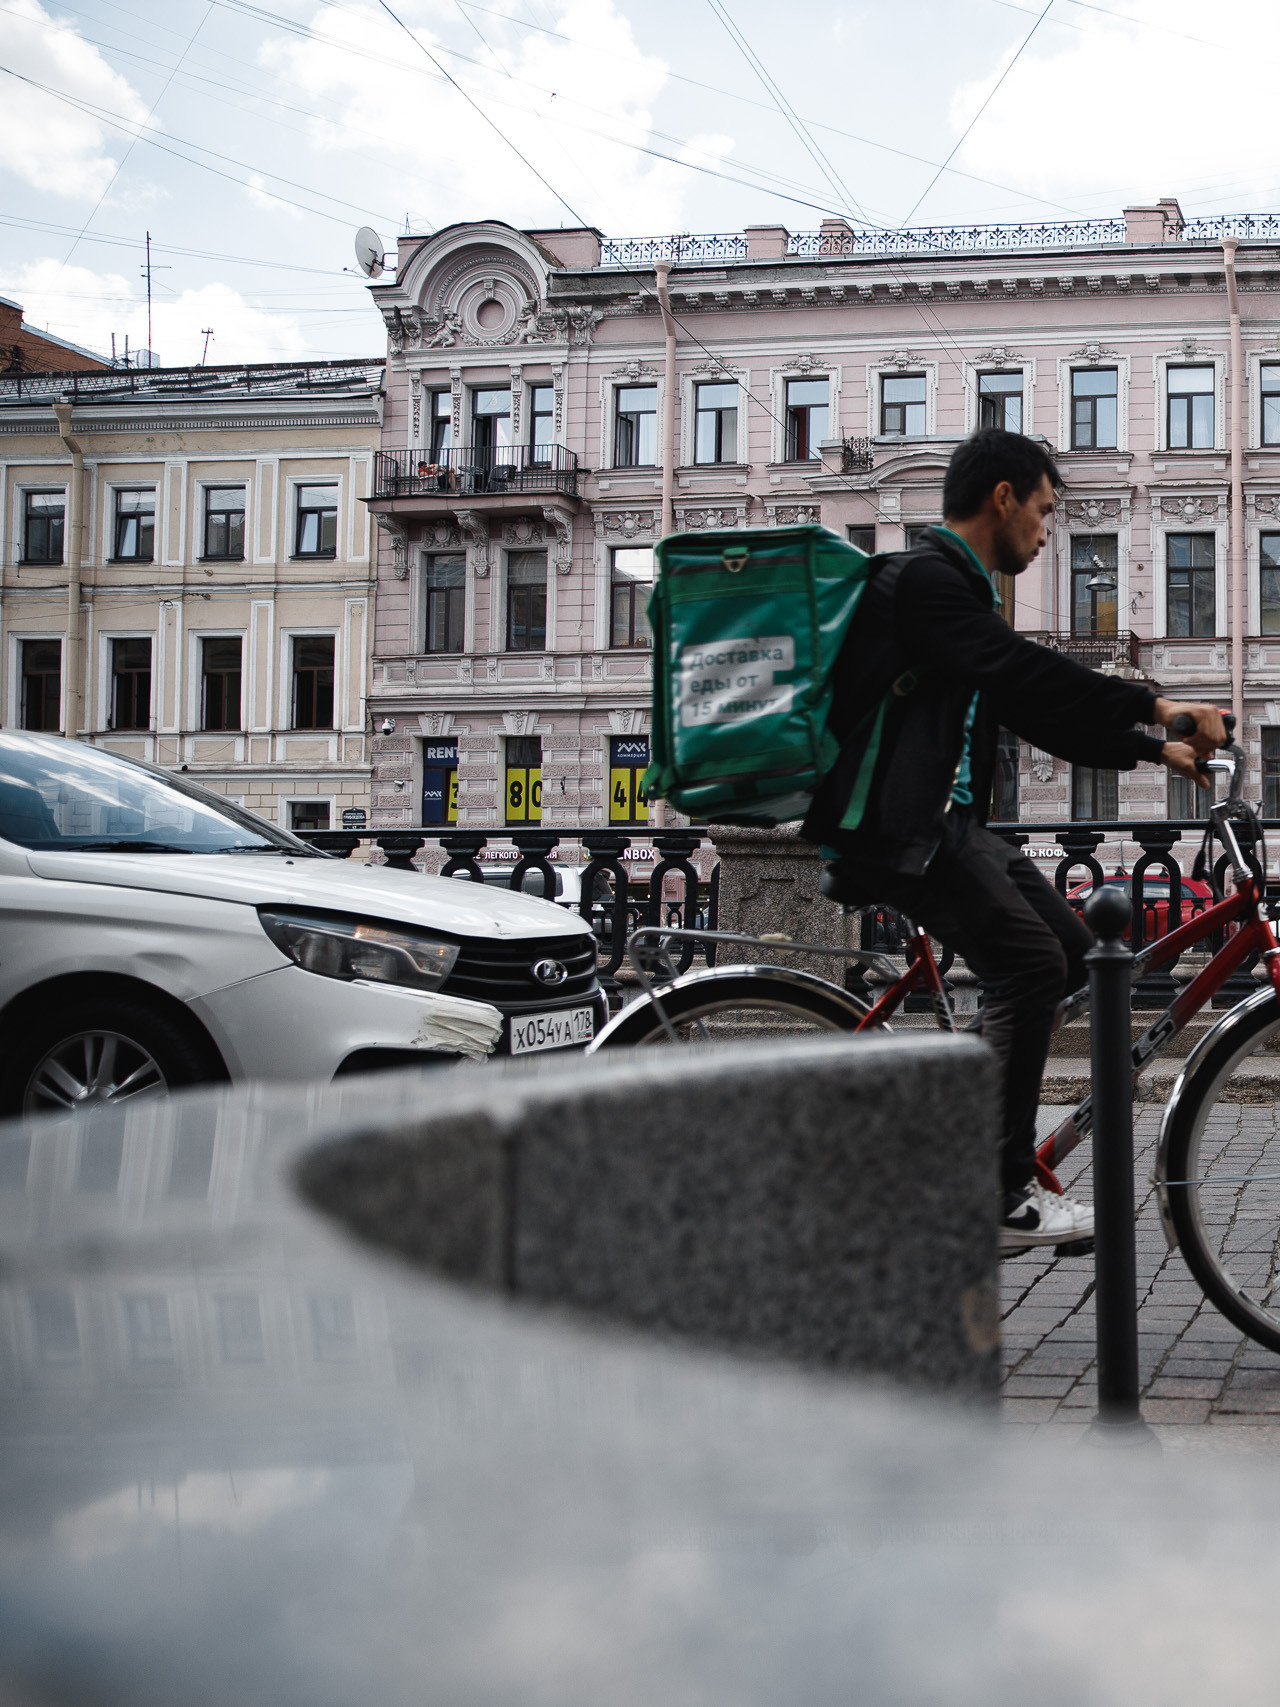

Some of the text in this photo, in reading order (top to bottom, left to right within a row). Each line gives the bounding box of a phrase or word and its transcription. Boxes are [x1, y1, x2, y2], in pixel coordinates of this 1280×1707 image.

[689, 647, 784, 670] Доставка
[690, 674, 760, 696] еды от
[692, 700, 712, 717] 15
[617, 849, 655, 860] NBOX
[573, 1010, 592, 1031] 178
